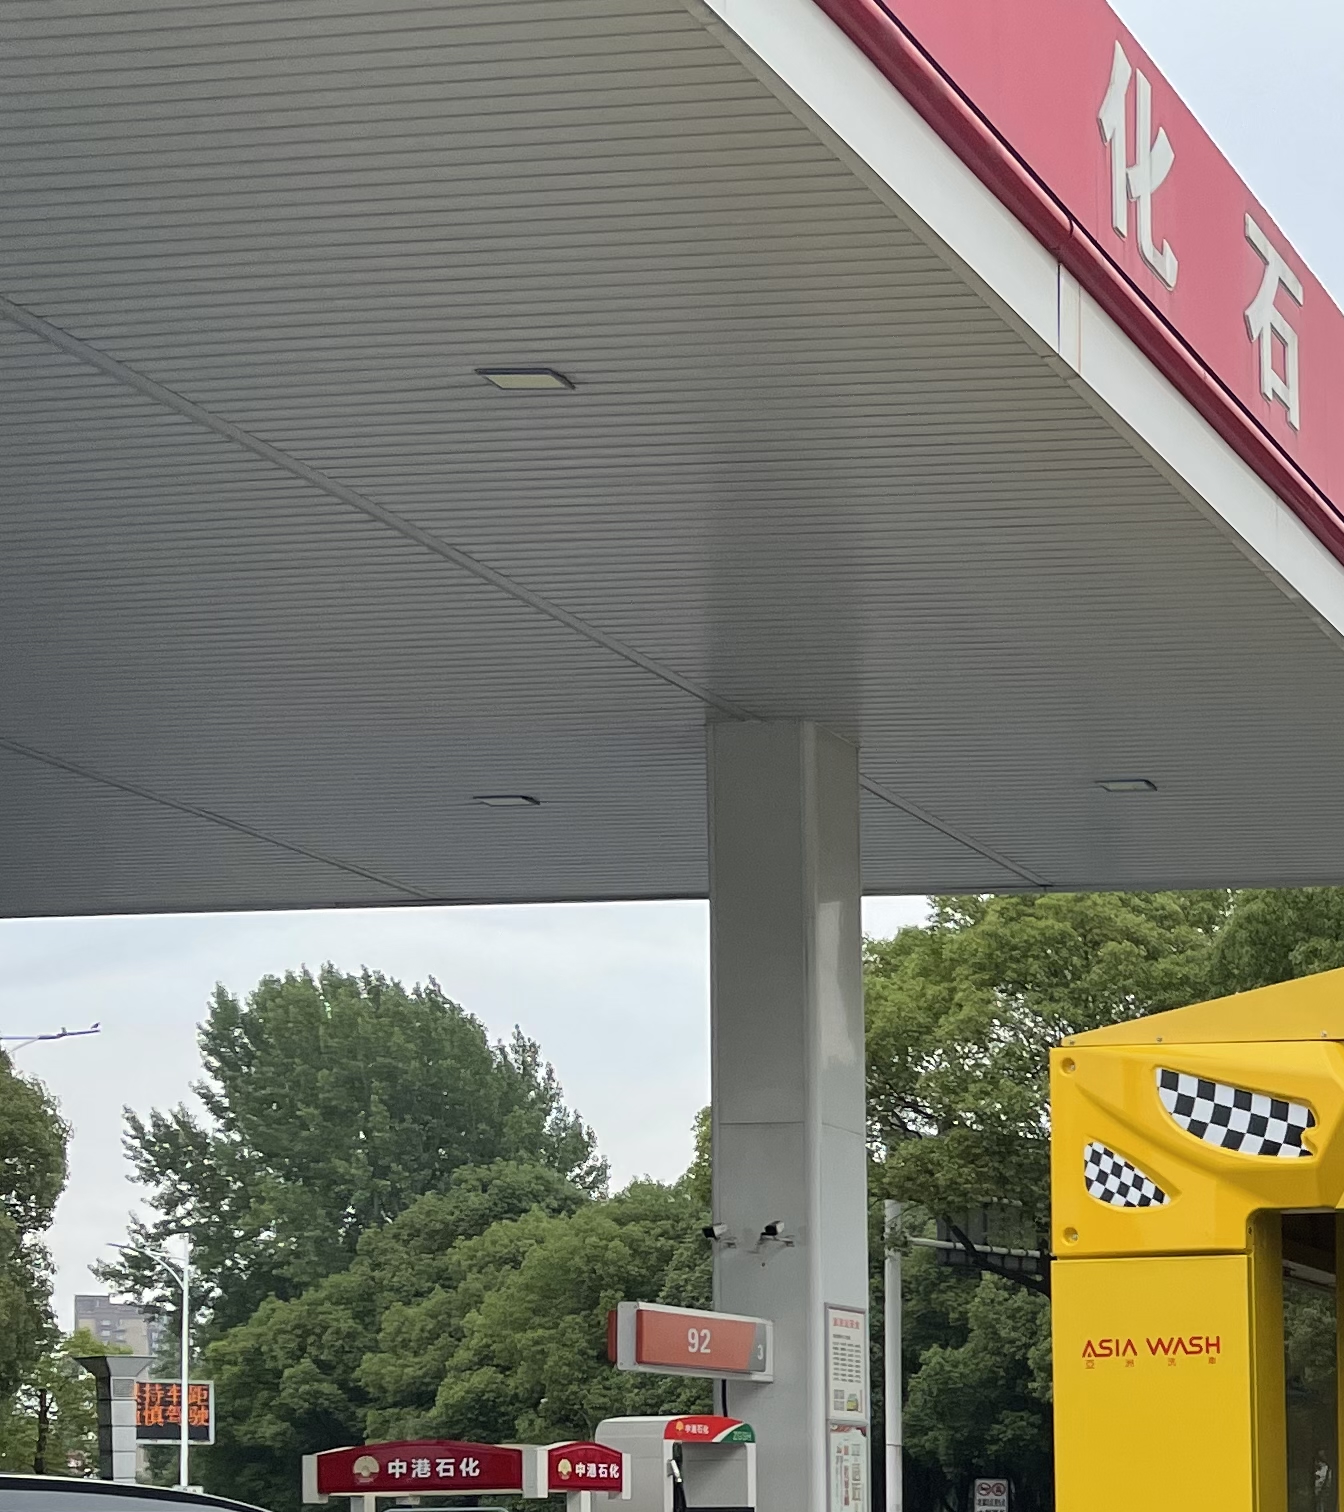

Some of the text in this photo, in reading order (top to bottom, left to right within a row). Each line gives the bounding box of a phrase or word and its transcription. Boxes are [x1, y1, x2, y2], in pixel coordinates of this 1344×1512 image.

[687, 1327, 711, 1353] 92
[1081, 1335, 1221, 1358] ASIA WASH
[757, 1344, 764, 1360] 3
[135, 1384, 210, 1405] 持车距
[135, 1405, 210, 1427] 慎驾驶
[387, 1457, 480, 1479] 中港石化
[575, 1462, 620, 1479] 中港石化
